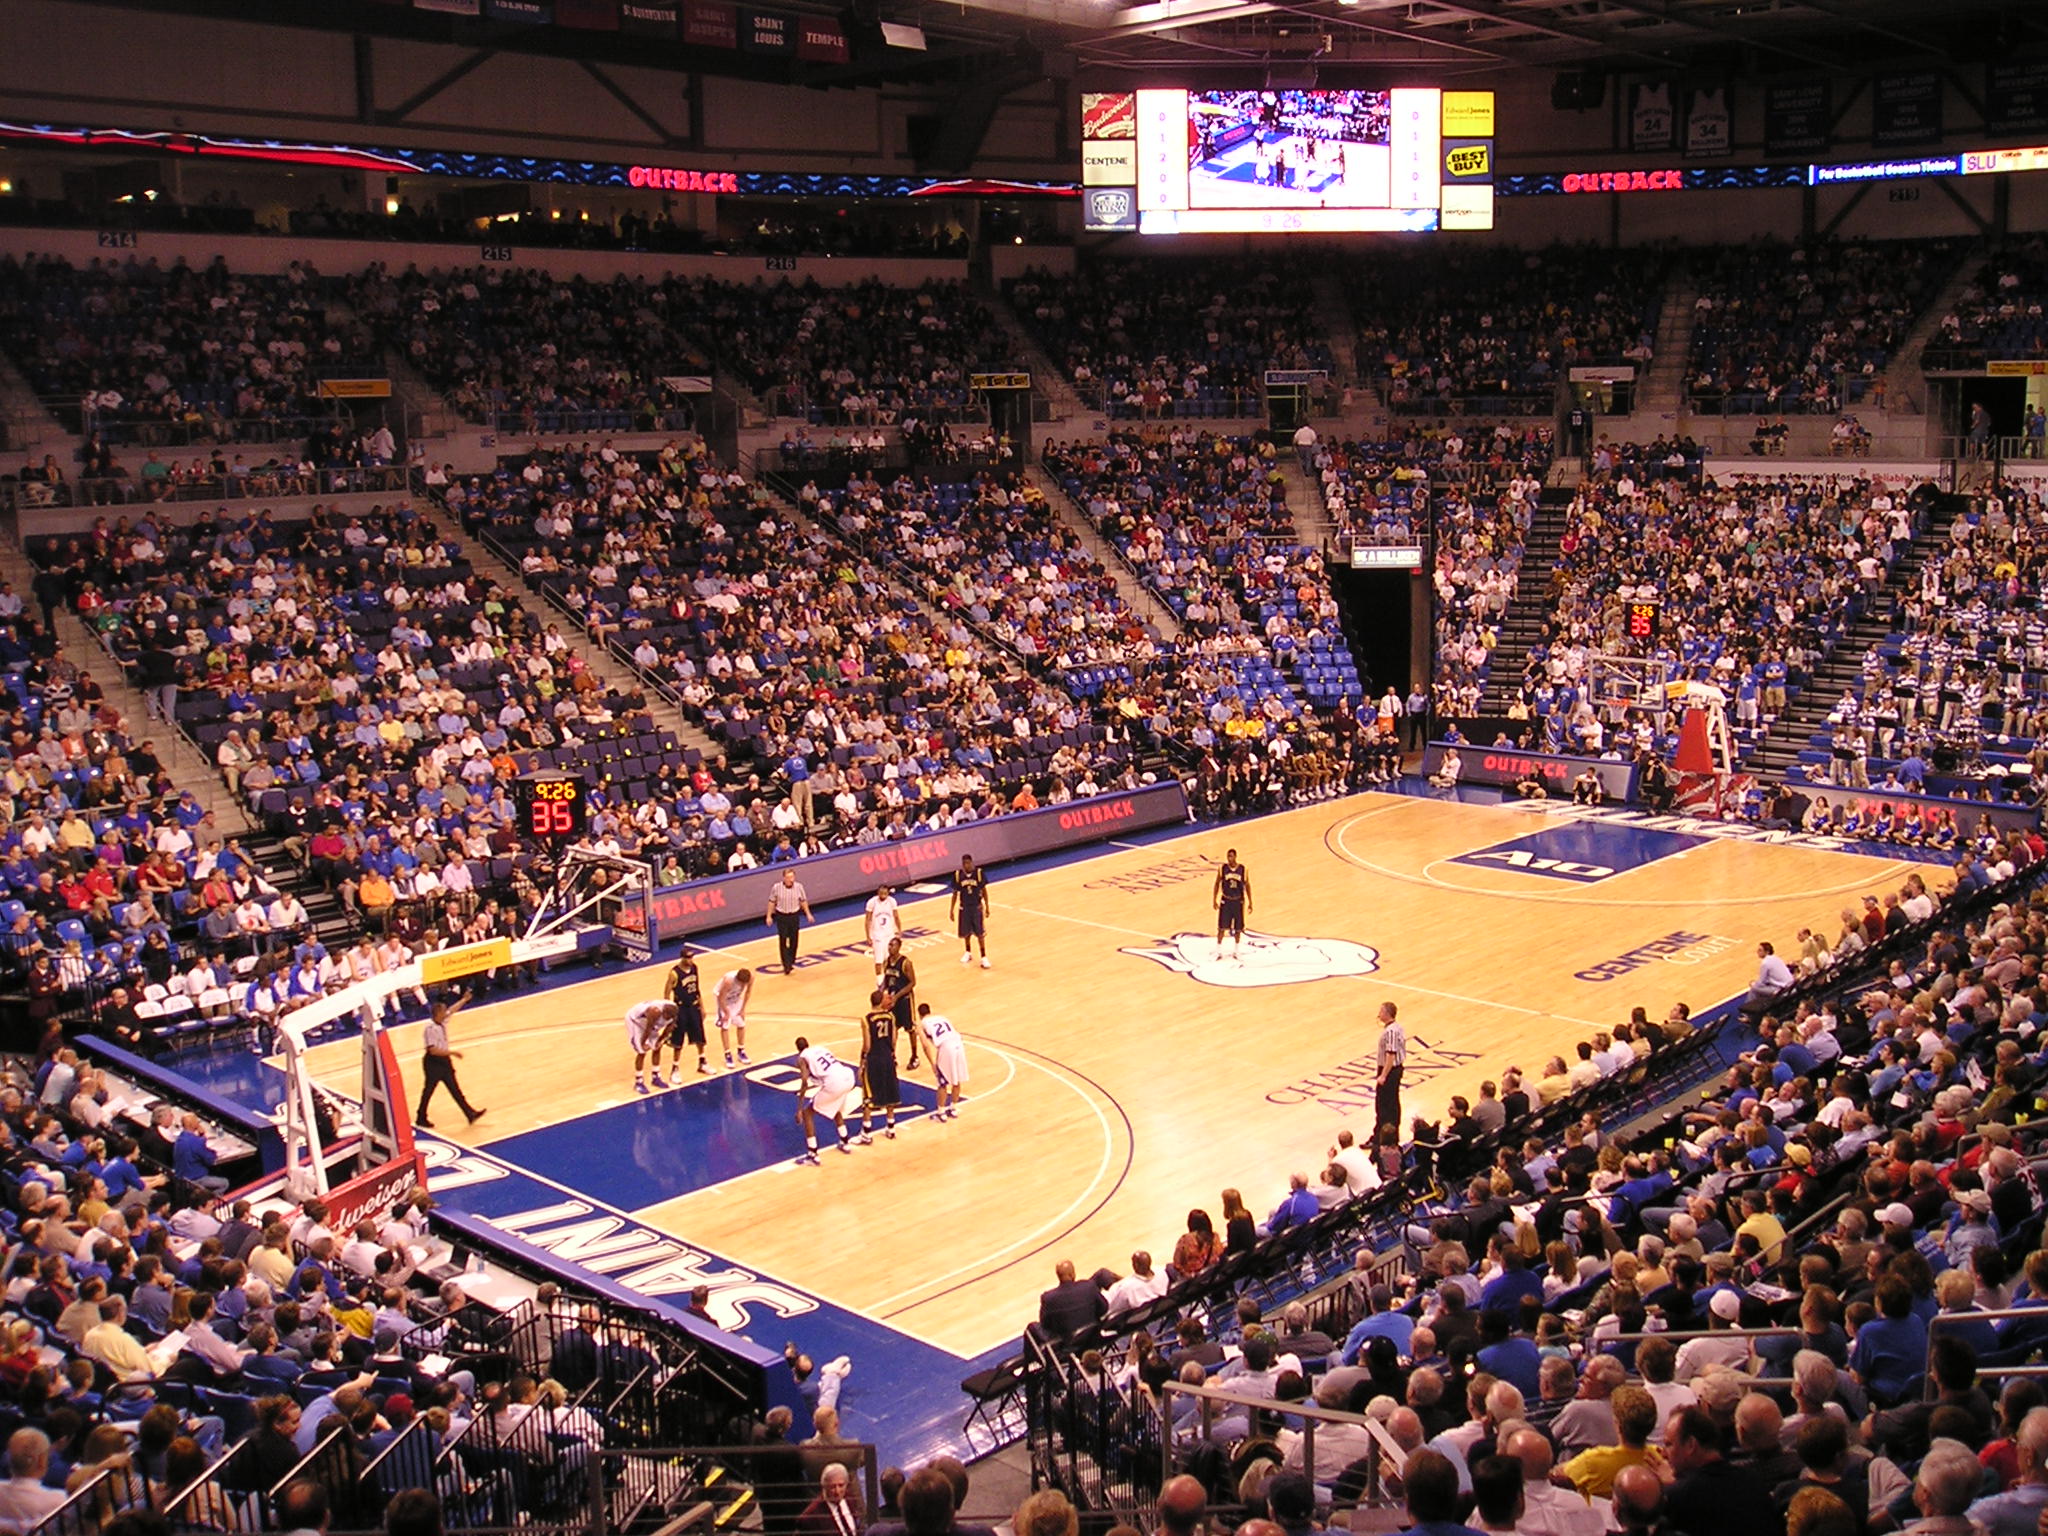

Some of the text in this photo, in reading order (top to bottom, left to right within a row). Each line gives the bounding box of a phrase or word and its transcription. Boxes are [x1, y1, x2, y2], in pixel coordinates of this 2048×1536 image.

[754, 17, 784, 30] SAINT
[754, 32, 784, 45] LOUIS
[806, 32, 844, 47] TEMPLE
[1644, 119, 1661, 131] 24
[1700, 124, 1717, 137] 34
[1084, 157, 1128, 166] CENTENE
[1452, 150, 1487, 163] BEST
[1966, 155, 1997, 171] SLU
[1454, 159, 1484, 172] BUY
[627, 164, 739, 194] OUTBACK
[1561, 169, 1683, 194] OUTBACK
[101, 232, 136, 247] 214
[483, 248, 511, 260] 215
[768, 258, 796, 270] 216
[1631, 615, 1651, 635] 35
[1483, 755, 1568, 778] OUTBCK
[535, 781, 576, 800] 9:26
[532, 801, 573, 833] 35
[1060, 801, 1135, 830] OUTBACK
[860, 841, 948, 875] OUTBACK
[1574, 930, 1711, 982] CENTENE
[1663, 935, 1744, 965] Court
[876, 1020, 889, 1038] 21
[934, 1021, 951, 1037] 21
